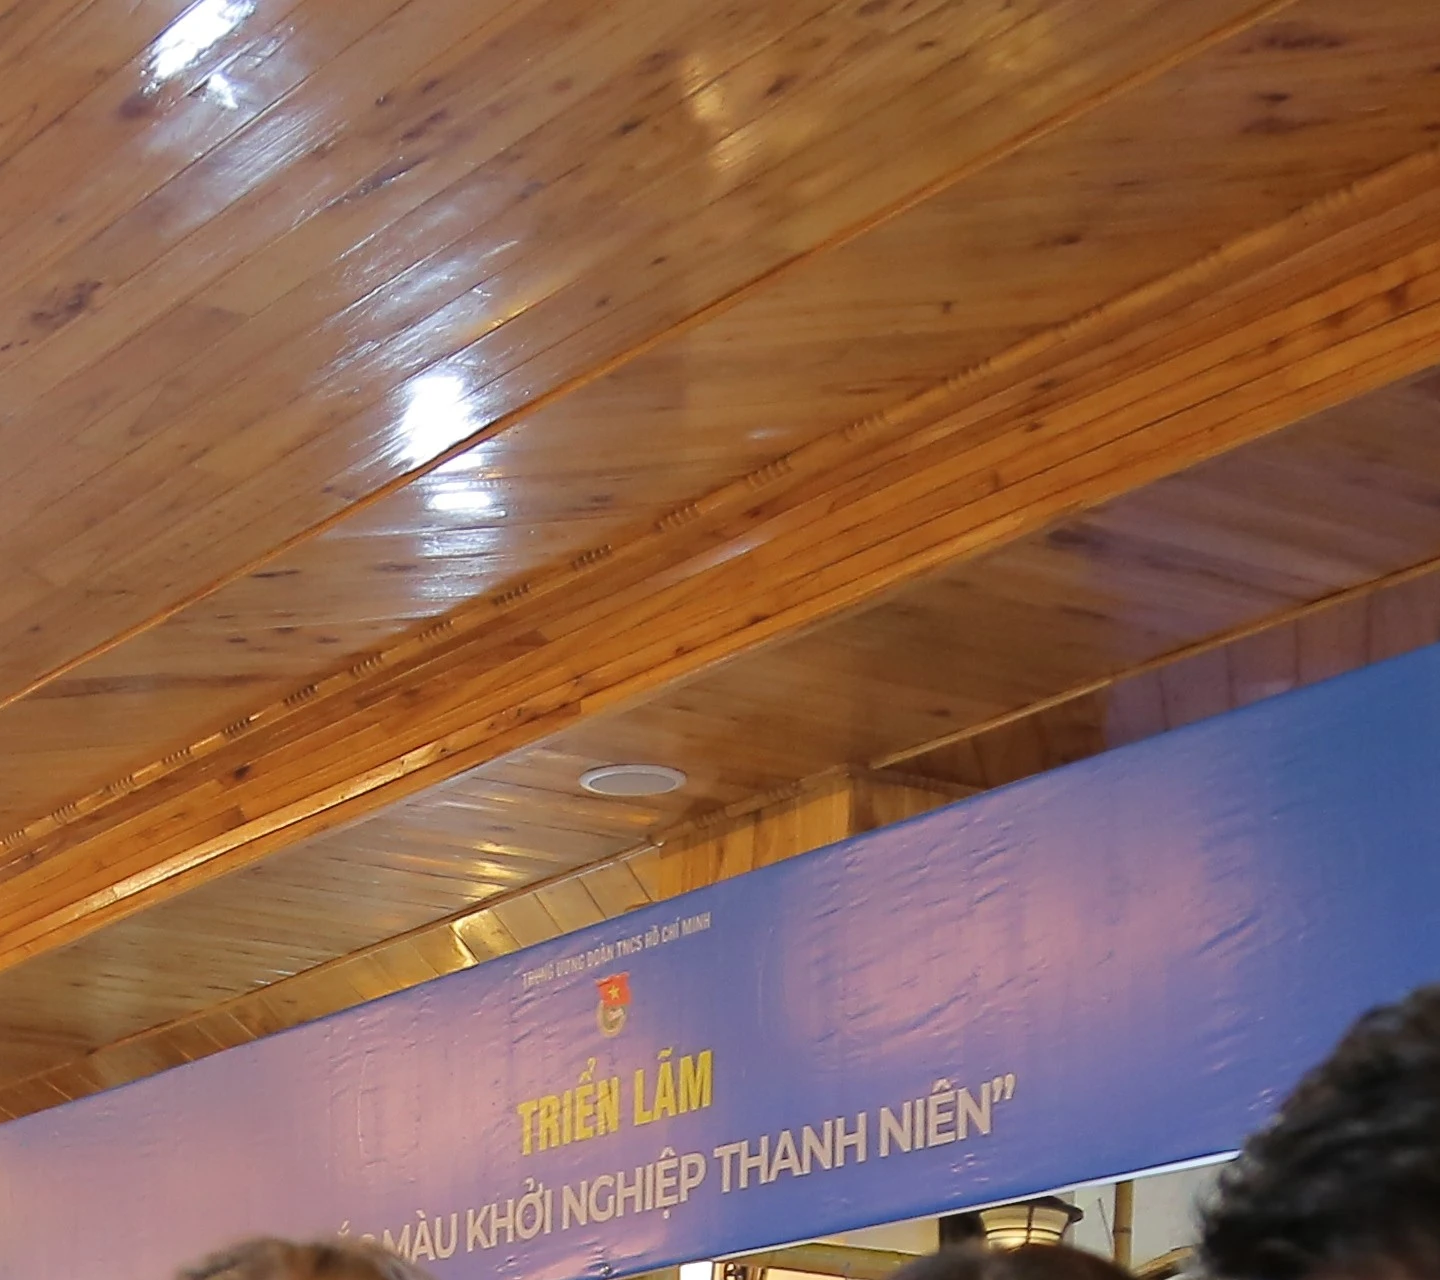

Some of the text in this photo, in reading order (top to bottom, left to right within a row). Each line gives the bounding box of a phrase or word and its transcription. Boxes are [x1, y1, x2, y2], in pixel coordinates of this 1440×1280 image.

[682, 912, 712, 936] MINH
[517, 1048, 712, 1156] TRIỂN LÃM
[383, 1073, 1016, 1265] MÀU KHỞI NGHIỆP THANH NIÊN”
